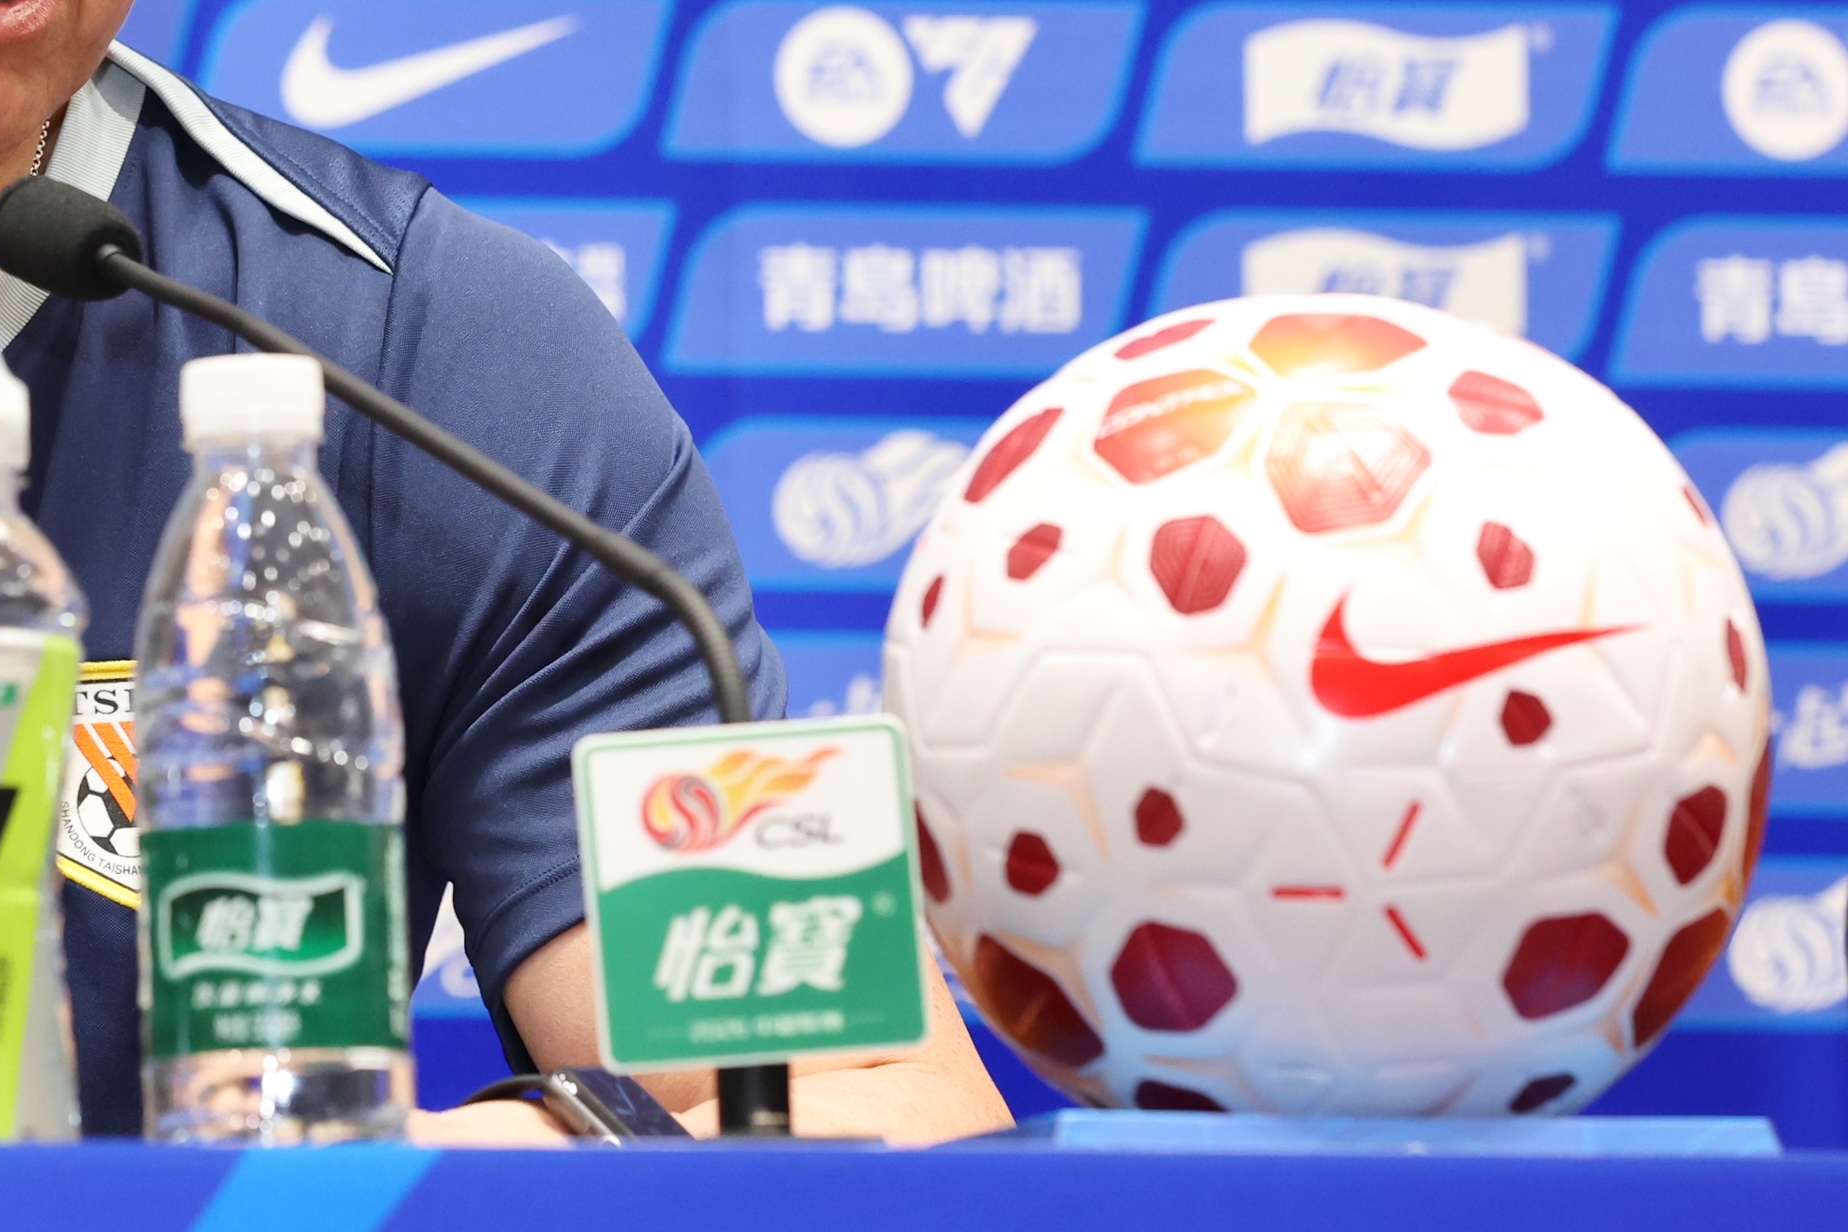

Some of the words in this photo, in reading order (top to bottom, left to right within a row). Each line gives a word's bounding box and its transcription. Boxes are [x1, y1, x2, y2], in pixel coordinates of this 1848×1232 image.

[75, 688, 135, 716] TS
[60, 800, 97, 863] SHANDONG
[756, 813, 846, 849] CSL
